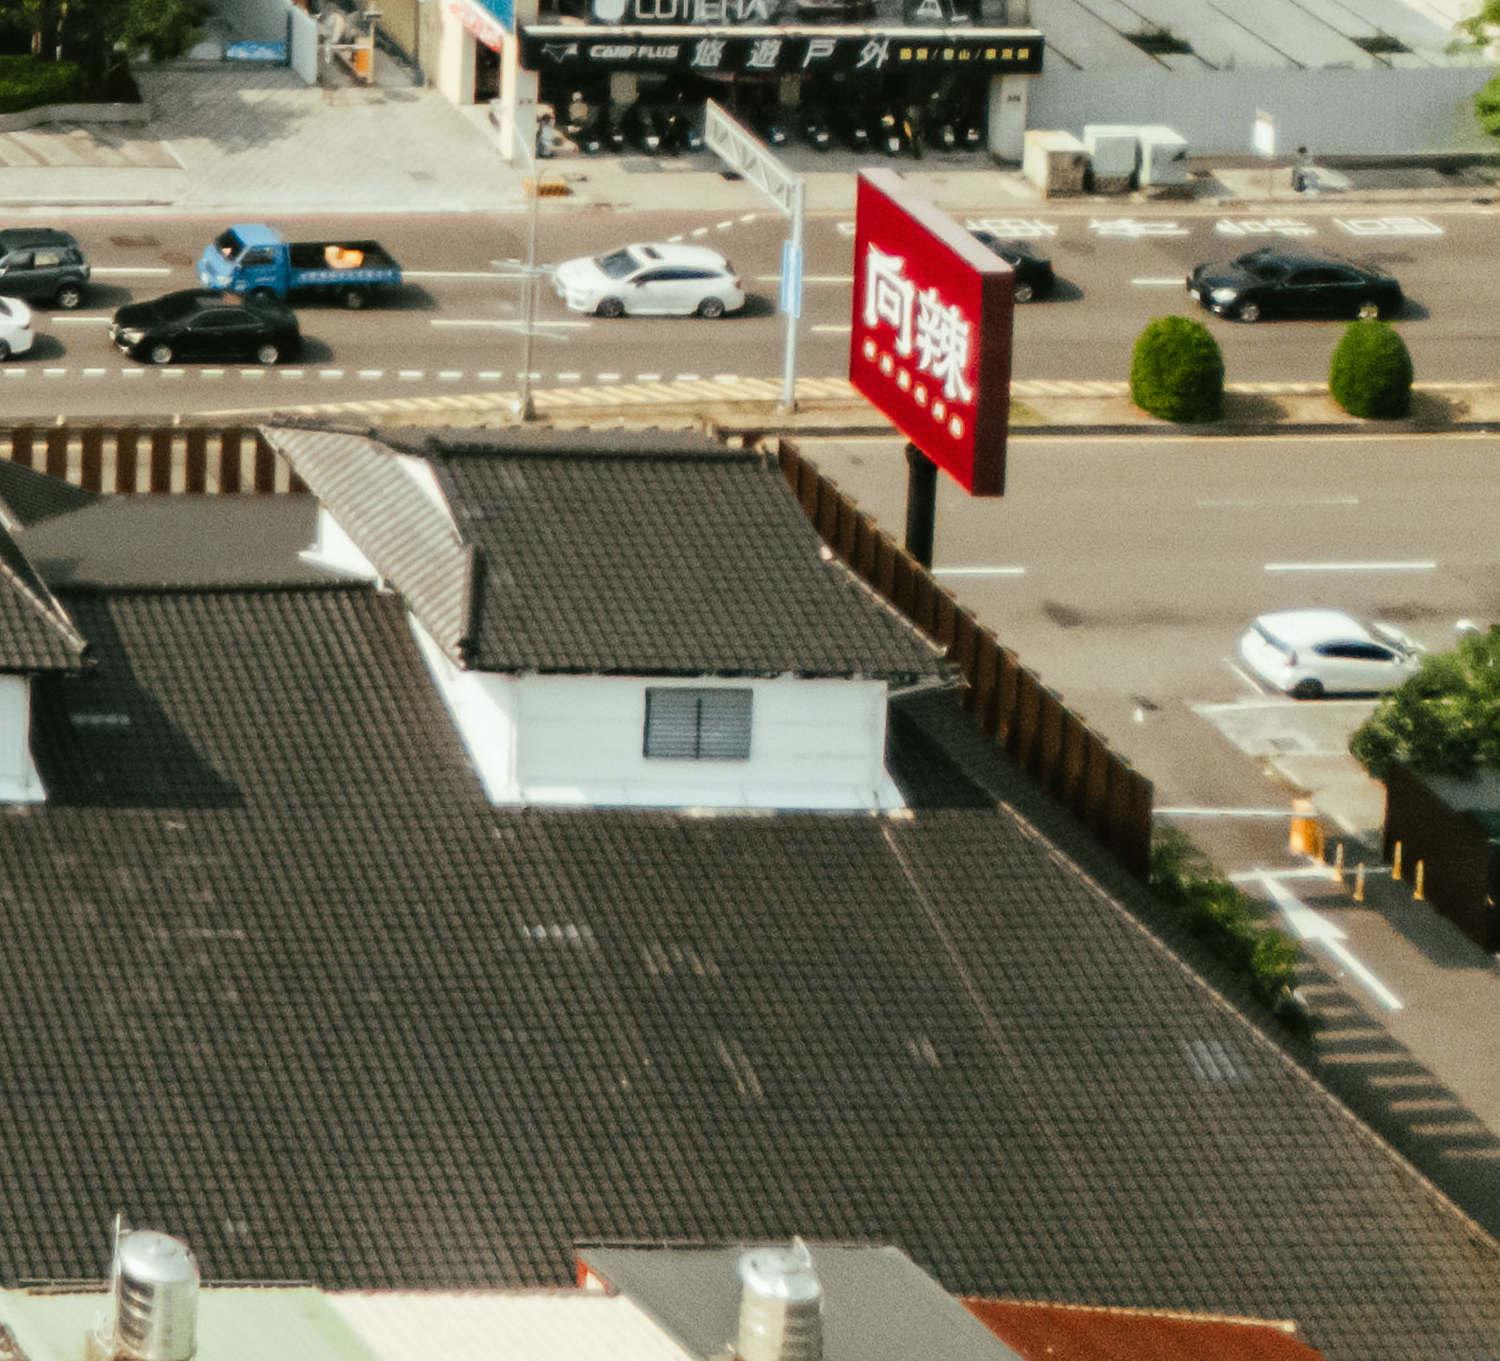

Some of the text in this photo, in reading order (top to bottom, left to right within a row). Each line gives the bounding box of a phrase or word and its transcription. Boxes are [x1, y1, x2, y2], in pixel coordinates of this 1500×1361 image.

[589, 43, 635, 58] CAMP
[637, 43, 680, 58] PLUS
[690, 38, 890, 70] 悠遊戶外
[862, 242, 974, 404] 向辣
